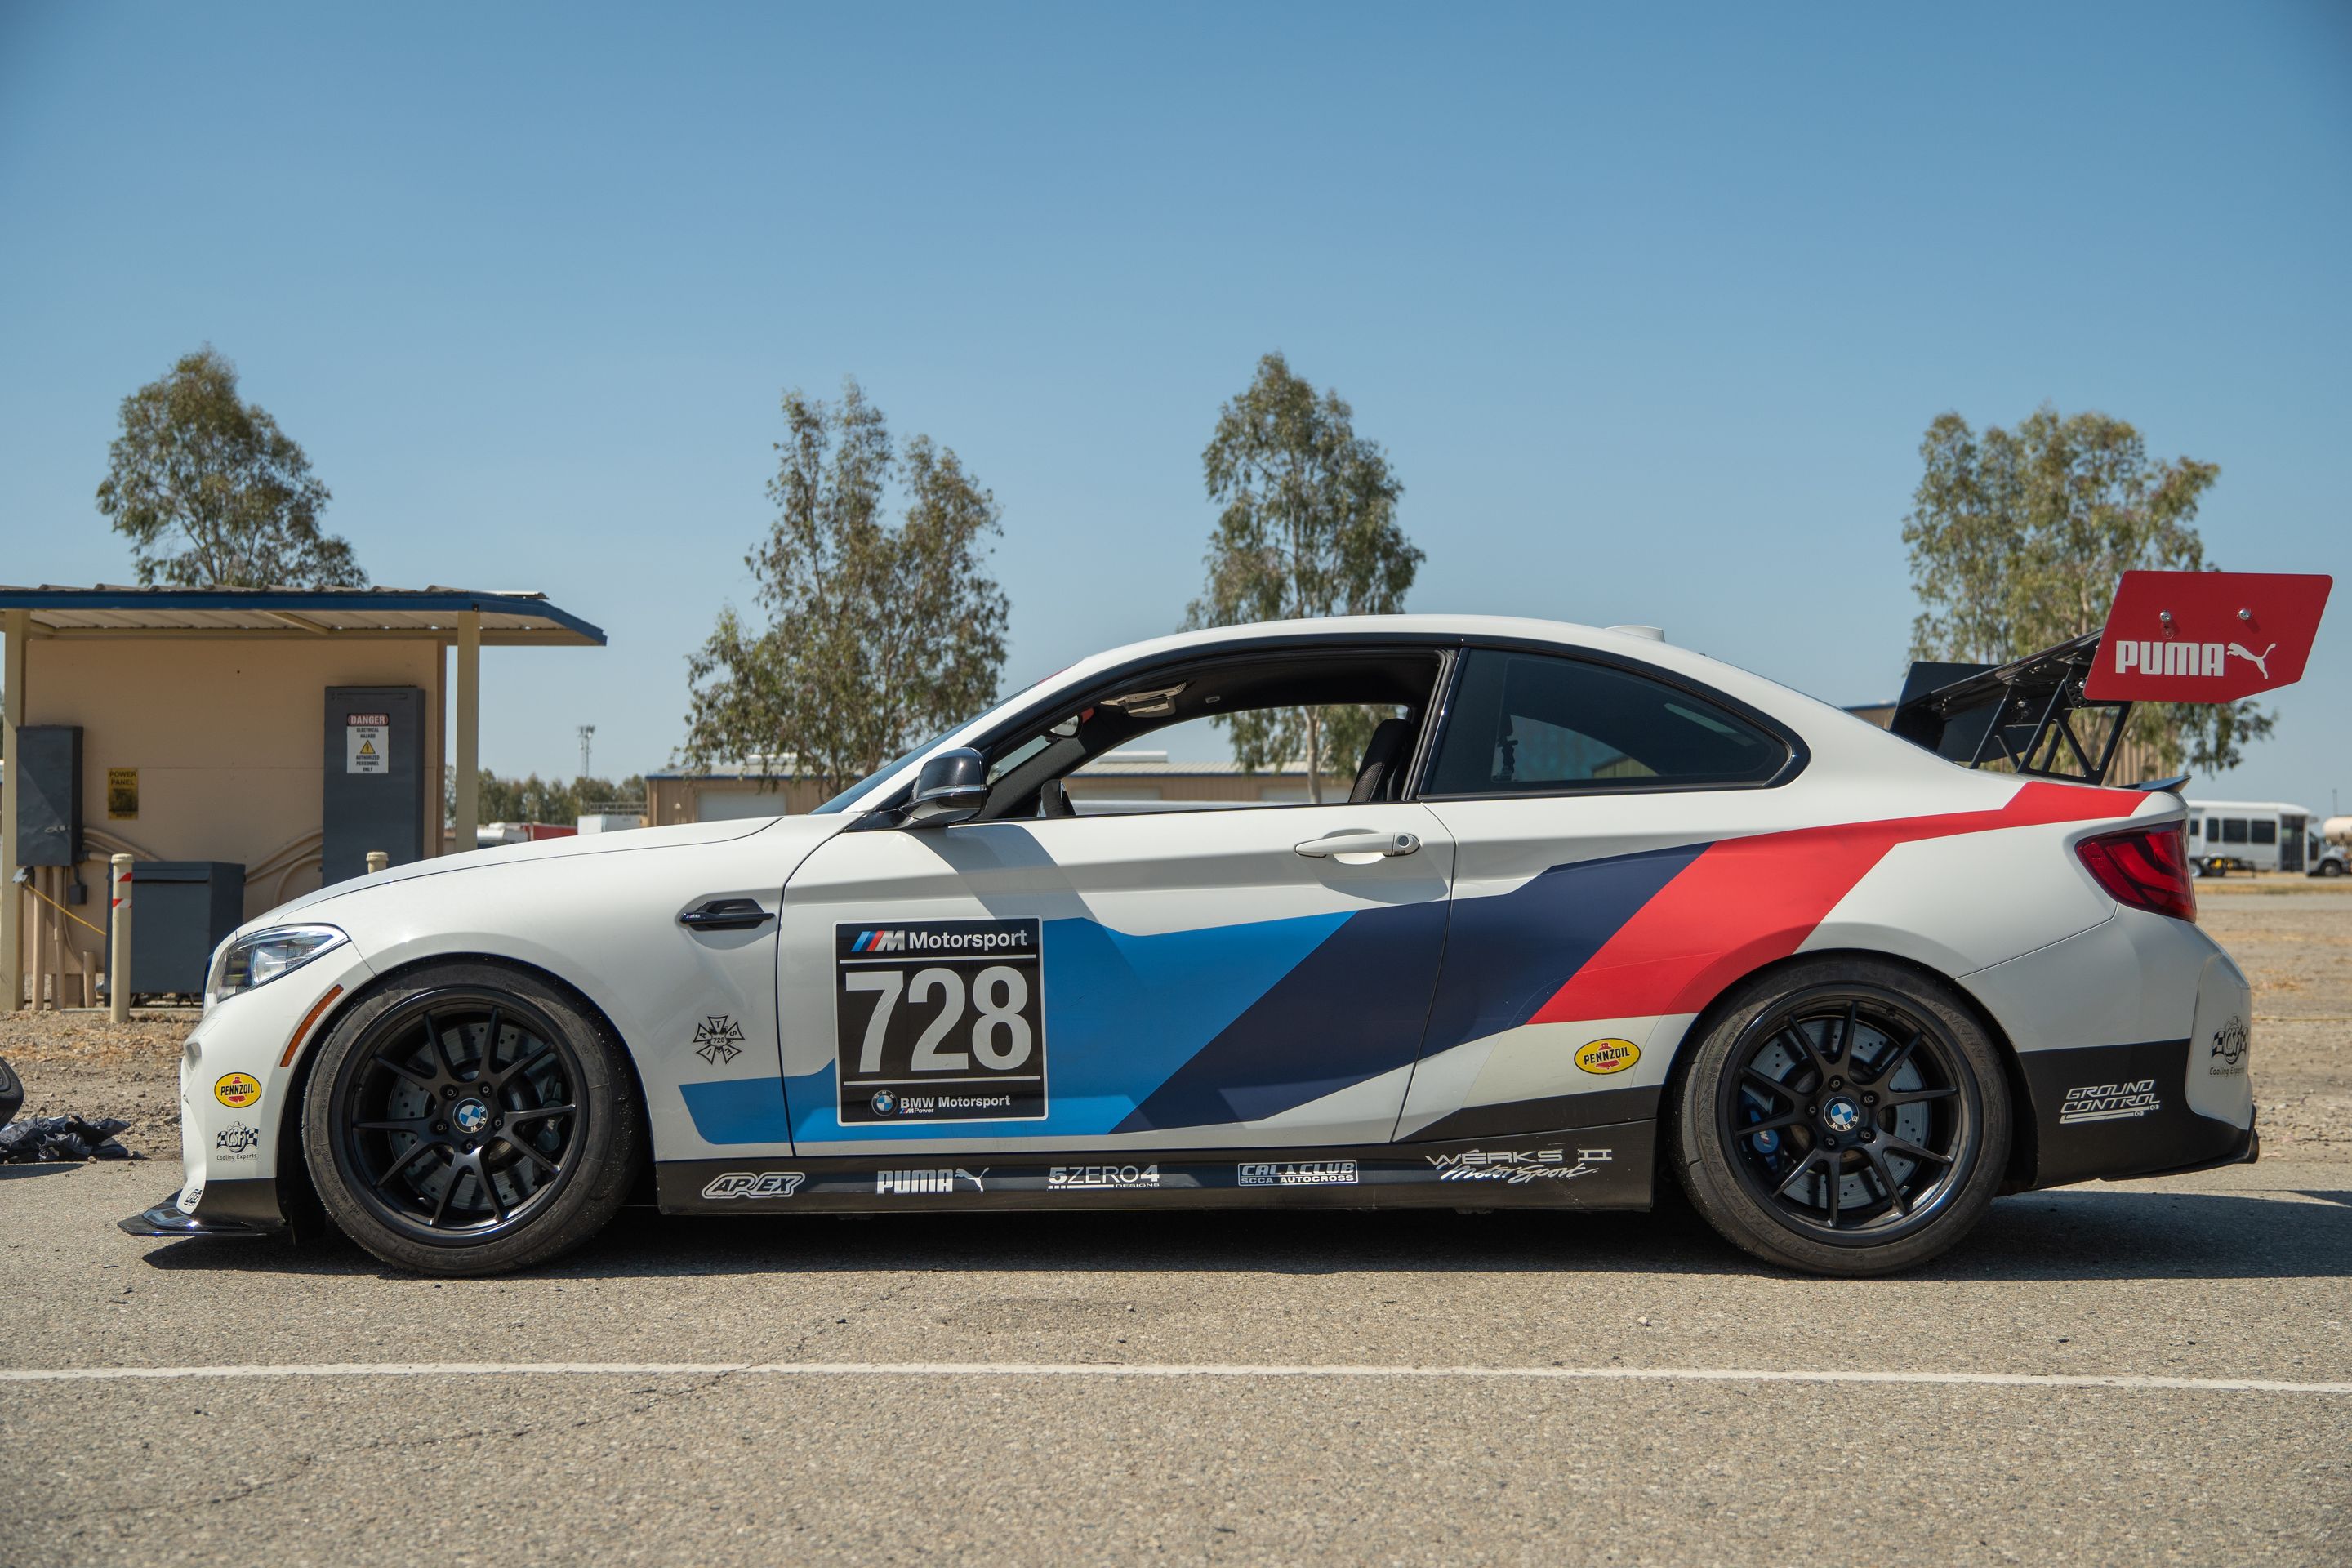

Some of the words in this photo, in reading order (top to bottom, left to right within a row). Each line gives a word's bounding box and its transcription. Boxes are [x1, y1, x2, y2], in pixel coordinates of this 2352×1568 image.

[2115, 640, 2225, 676] PUMA
[350, 715, 385, 724] DANGER
[909, 930, 1027, 951] Motorsport
[846, 966, 1032, 1072] 728
[1584, 1047, 1630, 1065] PENNZOIL
[2209, 1067, 2230, 1077] Cooling
[220, 1083, 254, 1096] PENNZOIL
[2065, 1080, 2154, 1100] GROUND
[900, 1097, 934, 1108] BMW
[938, 1095, 1011, 1108] Motorsport
[2060, 1093, 2160, 1114] CONTROL
[228, 1129, 245, 1147] CSF
[1425, 1149, 1563, 1165] WERKS
[1048, 1165, 1160, 1184] 5ZERO4
[1241, 1165, 1281, 1176] CAL
[1299, 1162, 1355, 1174] CLUB
[707, 1175, 801, 1195] APEX
[877, 1169, 953, 1194] PUMA
[1280, 1174, 1354, 1183] AUTOCROSS
